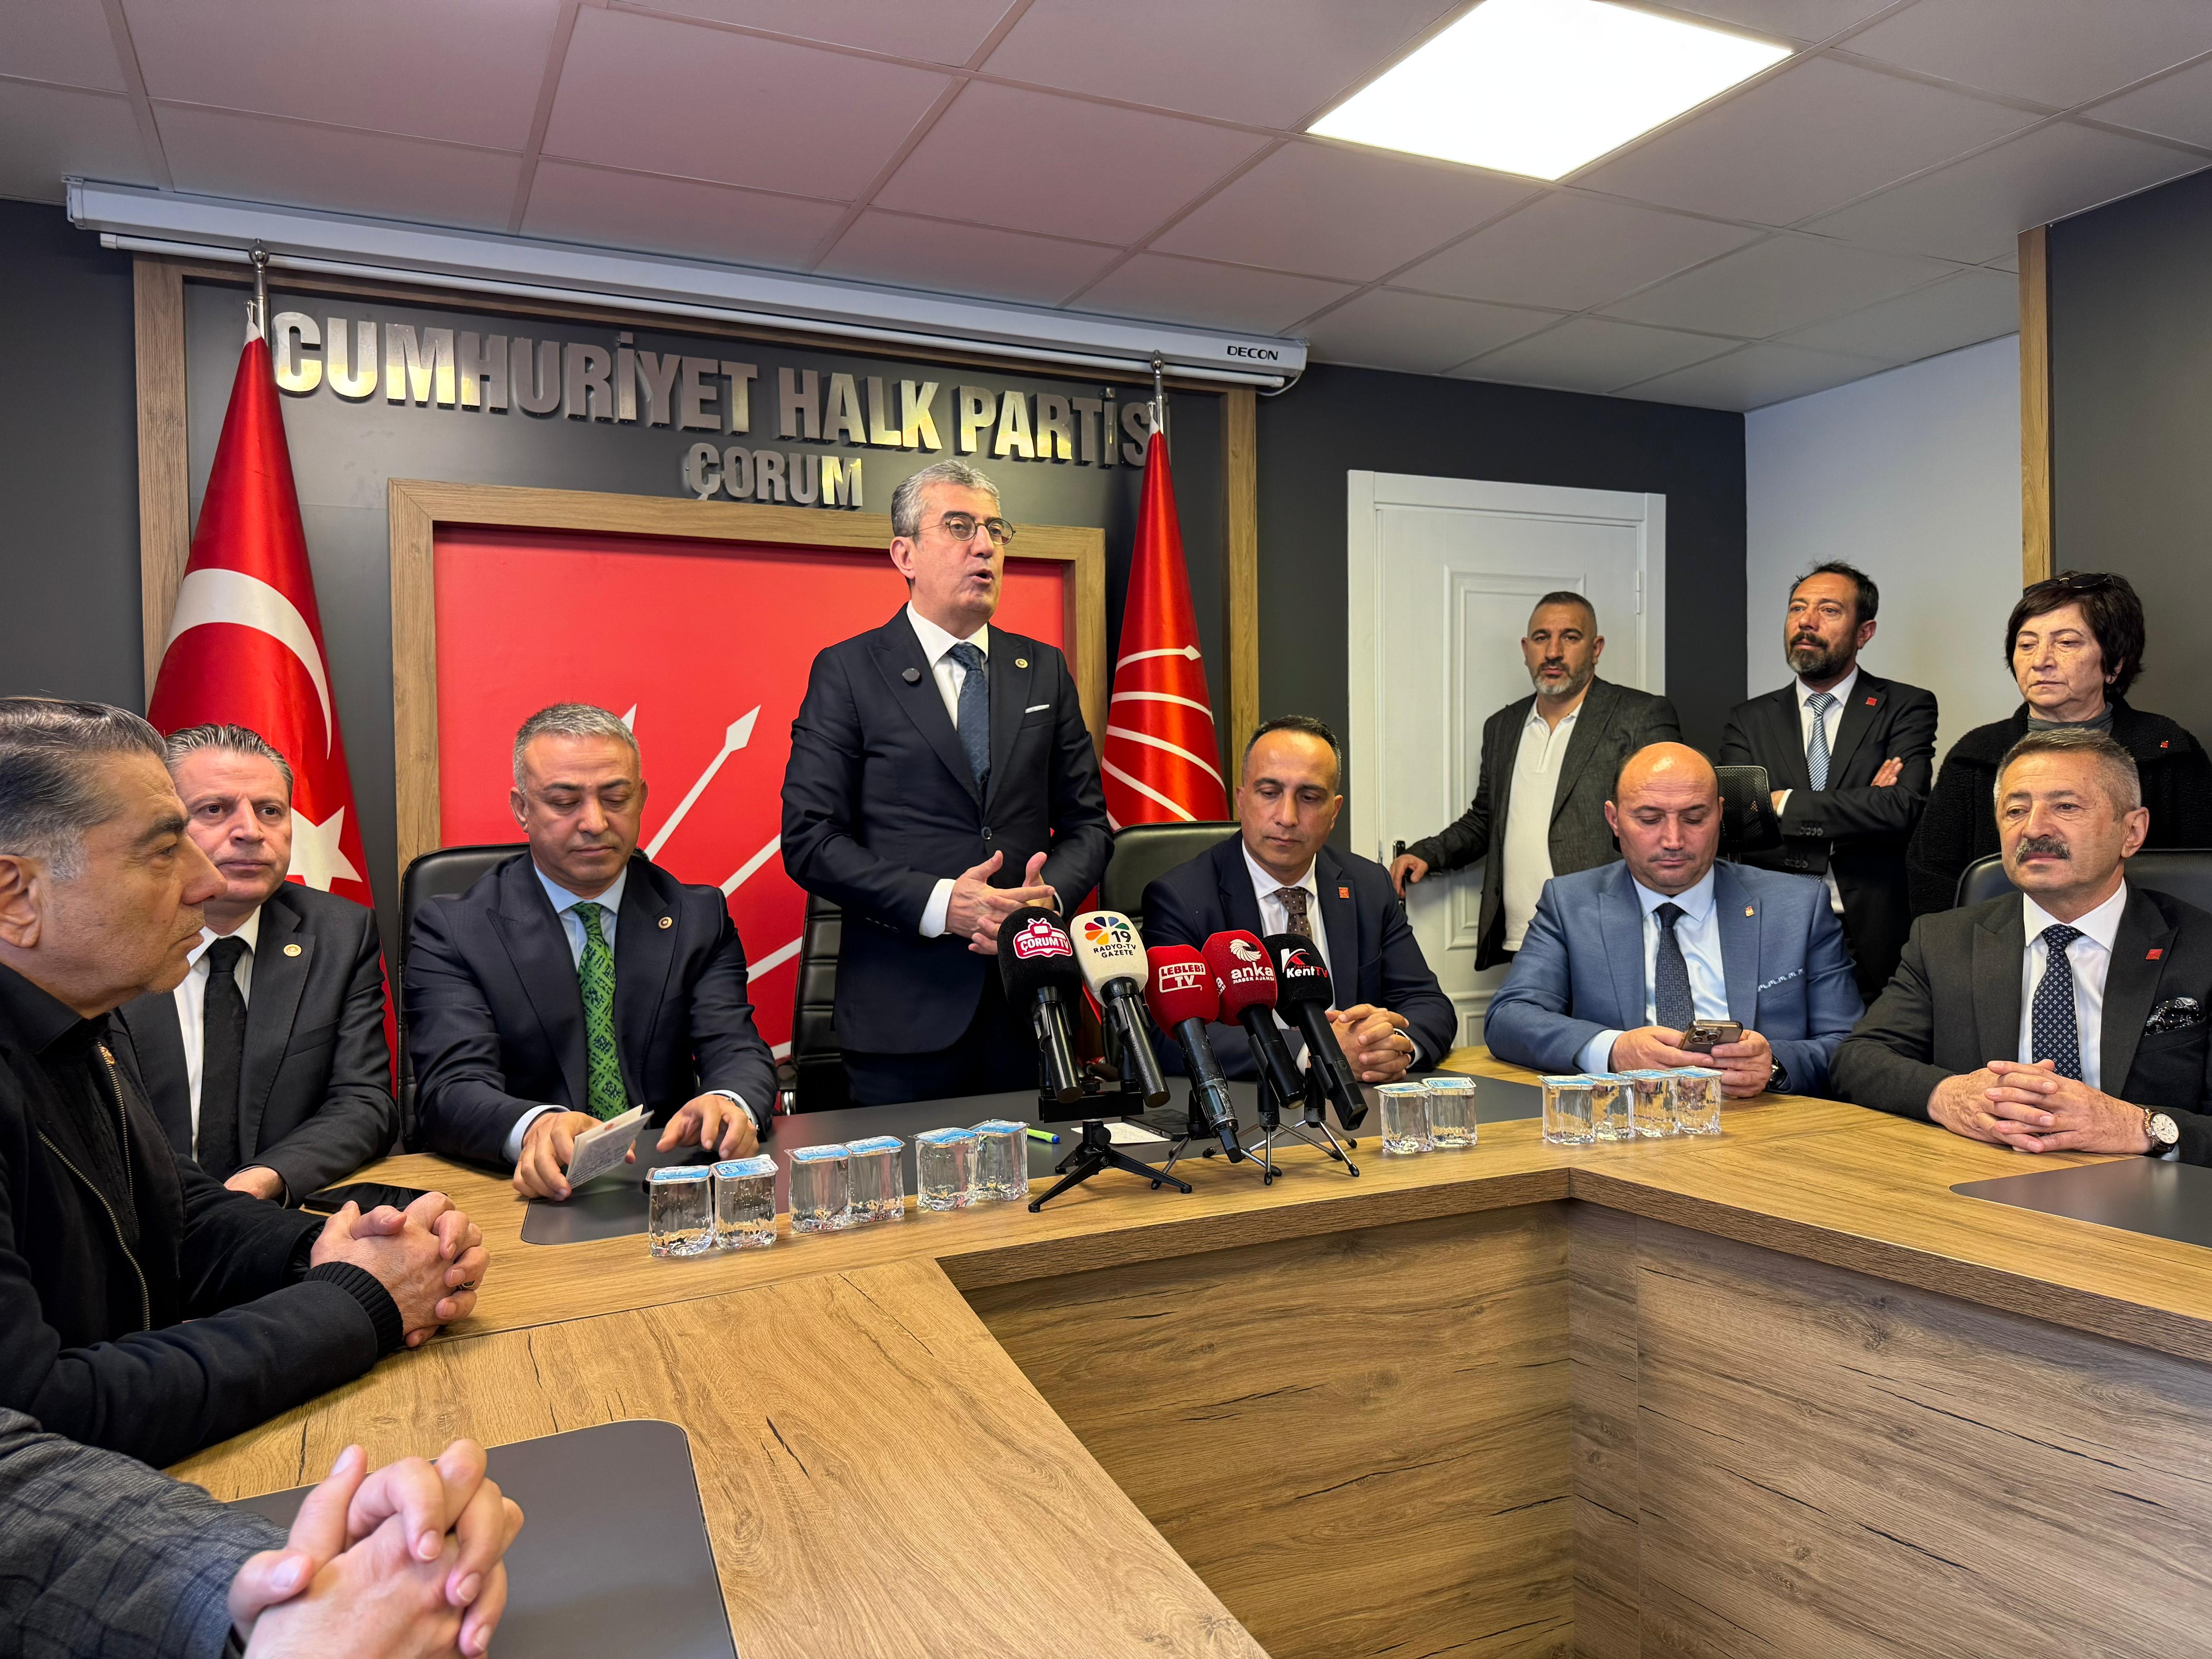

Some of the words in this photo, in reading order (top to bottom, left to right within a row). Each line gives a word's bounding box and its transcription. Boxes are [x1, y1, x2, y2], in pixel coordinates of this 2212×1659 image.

[1227, 346, 1278, 360] DECON
[273, 311, 757, 432] CUMHURİYET
[779, 367, 942, 450] HALK
[960, 385, 1171, 467] PARTİS
[690, 442, 862, 507] ÇORUM
[1111, 931, 1131, 942] 19
[1020, 937, 1059, 952] ÇORUM
[1058, 938, 1069, 950] TV
[1093, 944, 1136, 953] RADYO-TV
[1101, 950, 1133, 958] GAZETE
[1230, 962, 1274, 979] anka
[1175, 975, 1195, 987] TV
